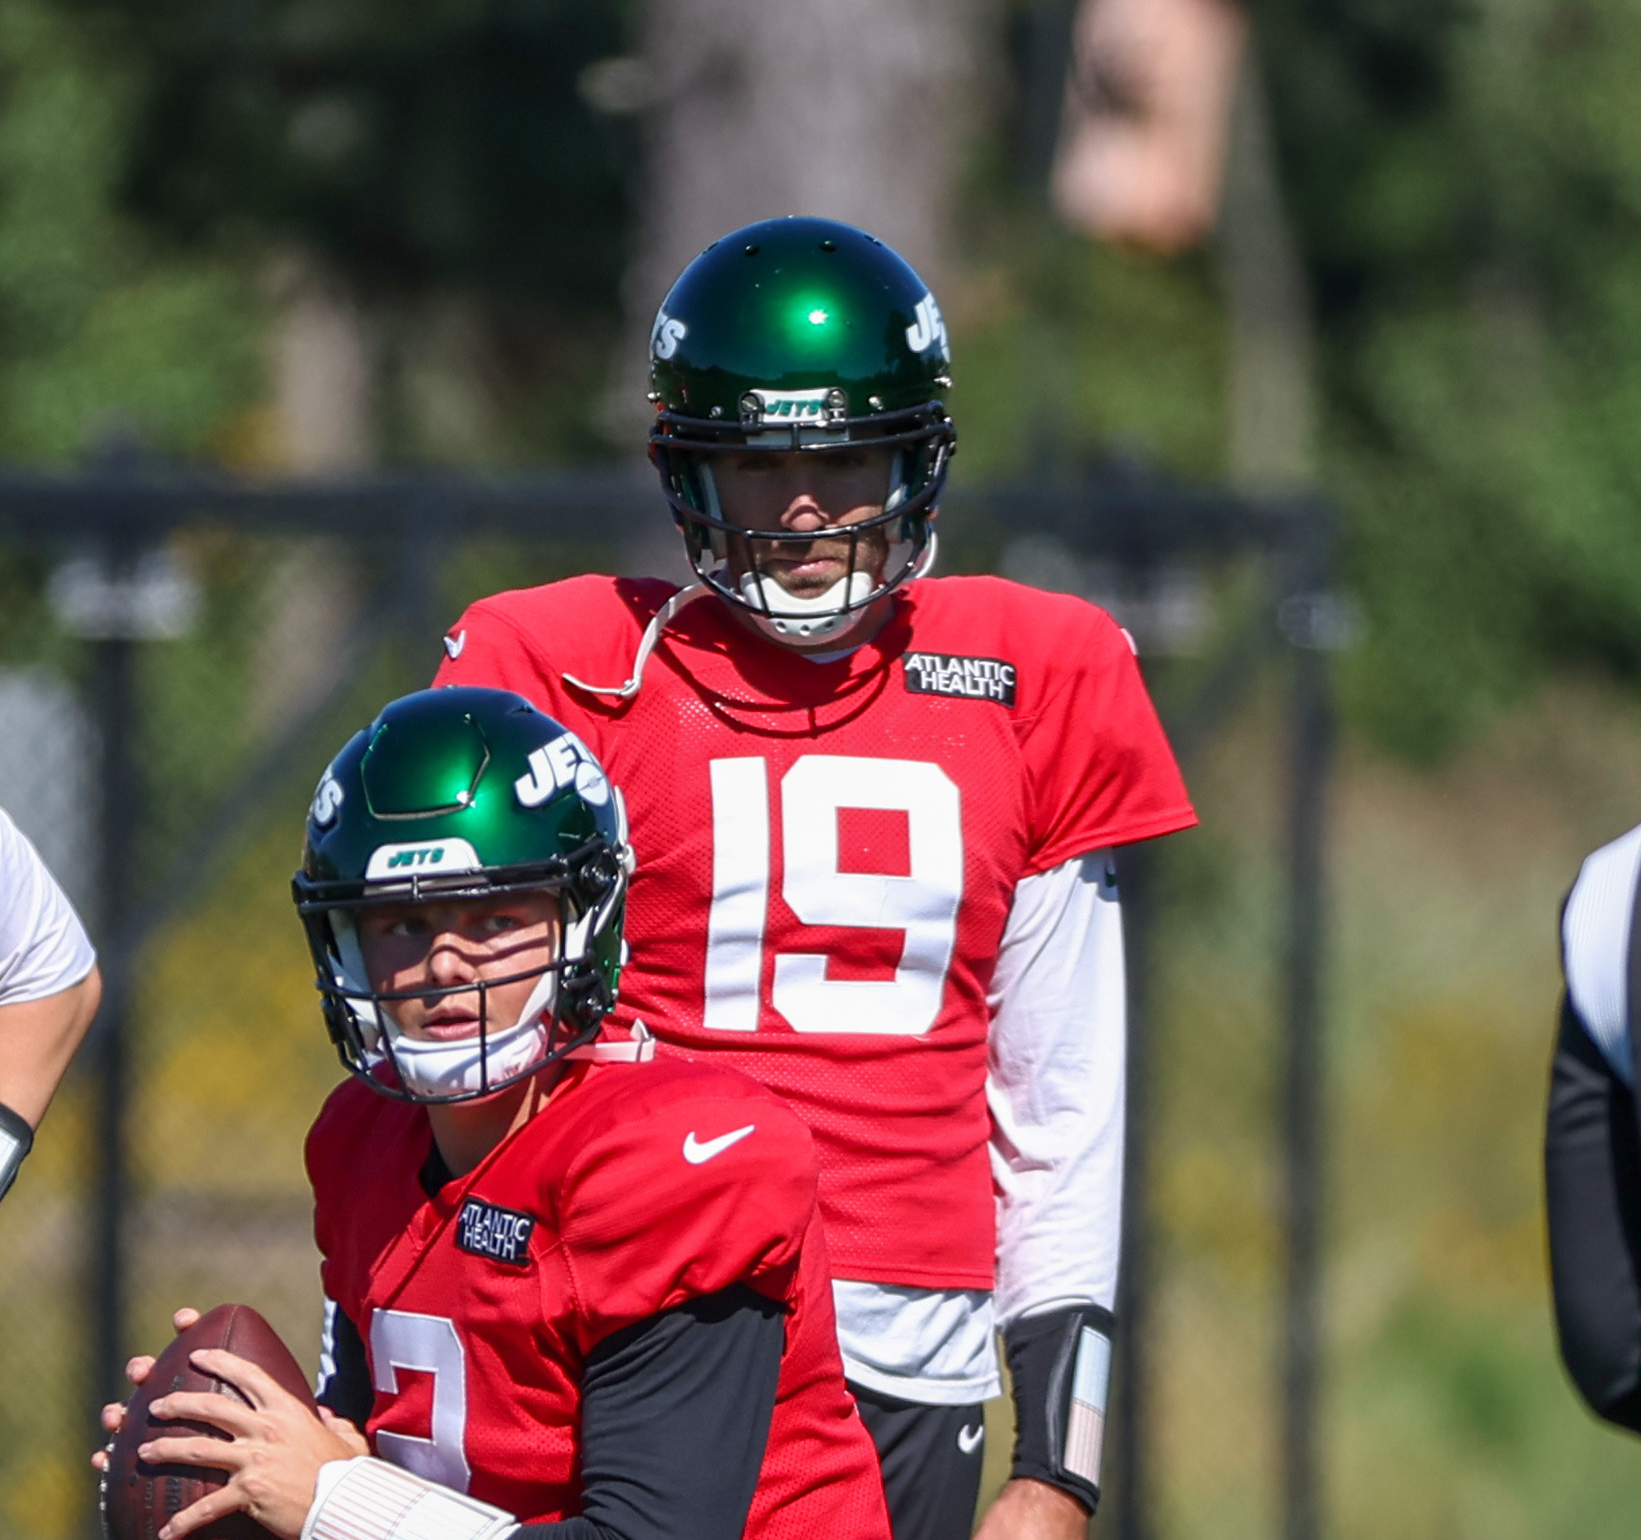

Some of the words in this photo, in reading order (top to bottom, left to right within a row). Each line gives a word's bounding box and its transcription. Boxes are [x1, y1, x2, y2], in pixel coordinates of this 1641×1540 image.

[764, 398, 825, 417] JETS
[904, 653, 1015, 686] ATLANTIC
[920, 670, 1004, 701] HEALTH
[386, 846, 445, 870] JETS
[702, 754, 964, 1036] 19
[459, 1202, 530, 1242] ATLANTIC
[463, 1224, 516, 1261] HEALTH
[369, 1307, 471, 1497] 2
